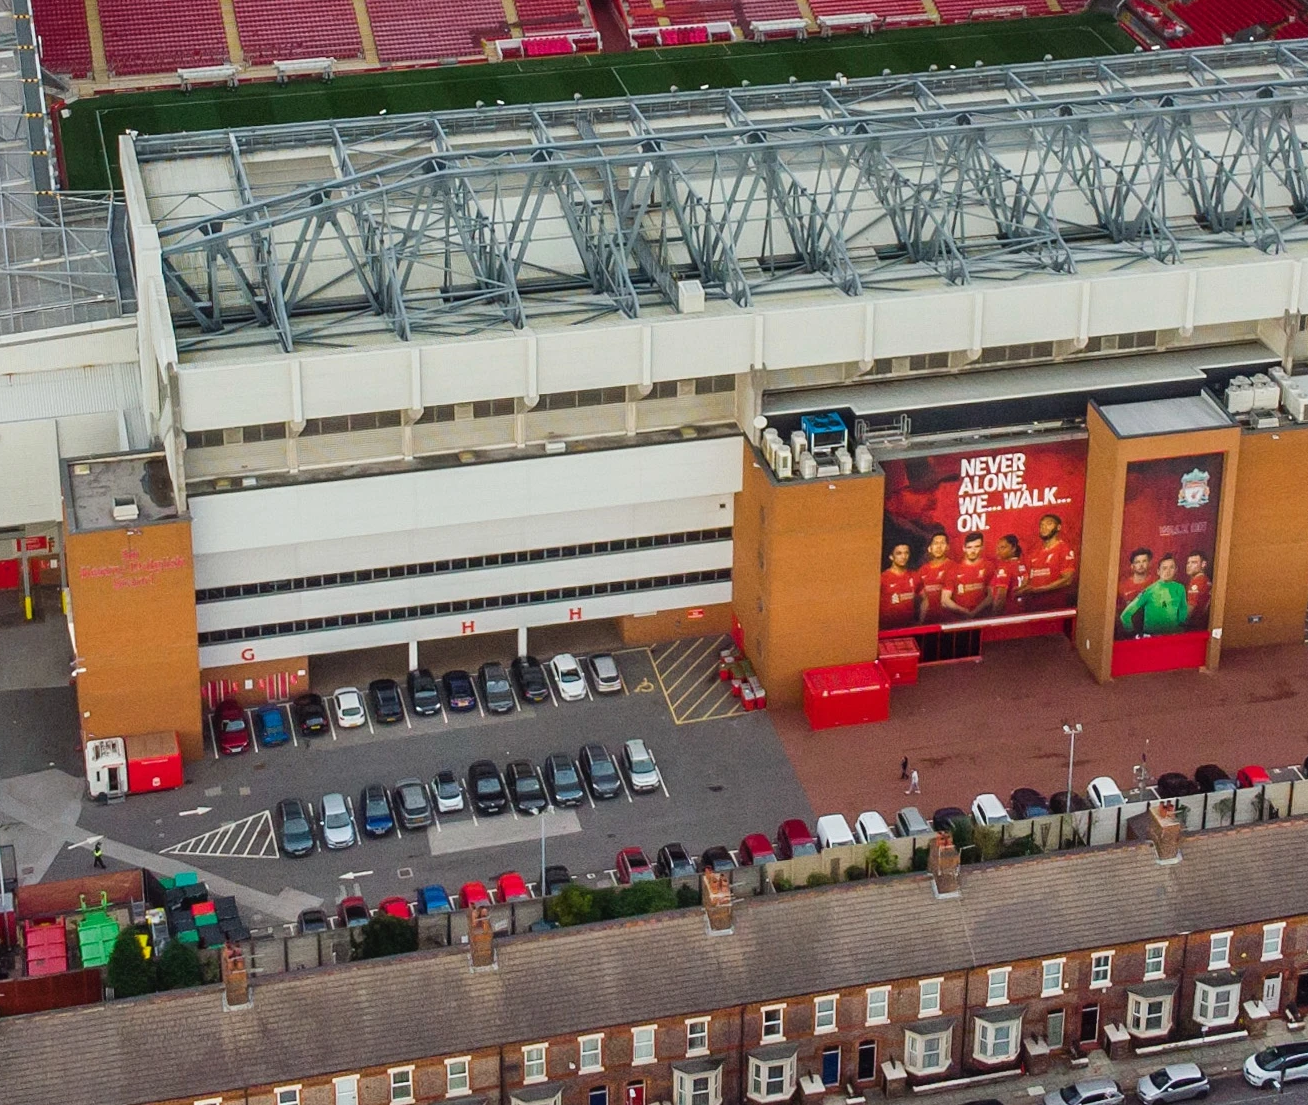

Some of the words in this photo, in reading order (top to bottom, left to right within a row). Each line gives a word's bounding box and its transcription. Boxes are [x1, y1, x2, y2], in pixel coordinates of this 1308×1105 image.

[961, 452, 1026, 477] NEVER
[958, 471, 1027, 495] ALONE,
[958, 494, 1002, 515] WE...
[1003, 487, 1072, 510] WALK...
[957, 513, 990, 533] ON.
[569, 607, 582, 621] H
[462, 621, 475, 634] H
[241, 648, 255, 661] G
